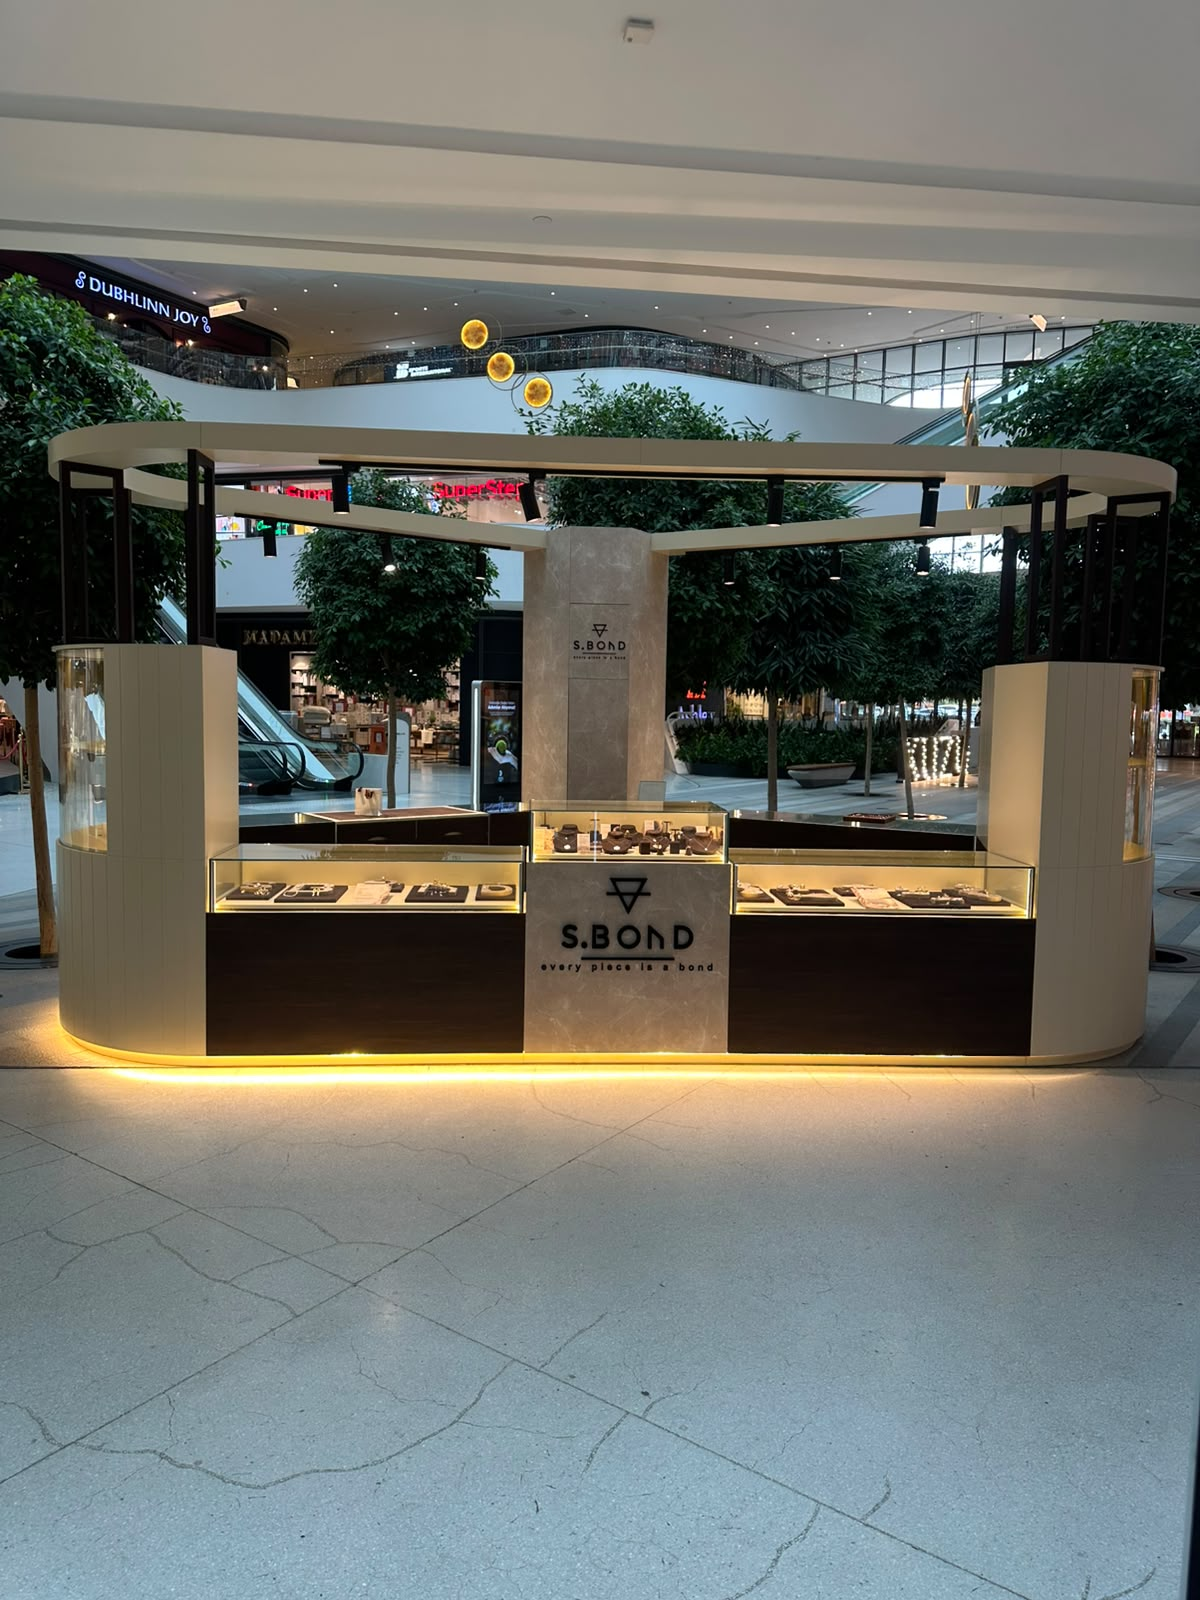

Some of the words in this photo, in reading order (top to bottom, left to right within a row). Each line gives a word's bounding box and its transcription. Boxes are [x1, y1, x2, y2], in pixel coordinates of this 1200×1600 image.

[89, 276, 170, 318] DUBHLINN
[173, 308, 200, 328] JOY
[561, 924, 694, 950] S.BOND
[541, 963, 582, 972] every
[591, 962, 631, 972] piece
[640, 962, 653, 972] is
[662, 963, 669, 972] a
[678, 962, 714, 972] bond
